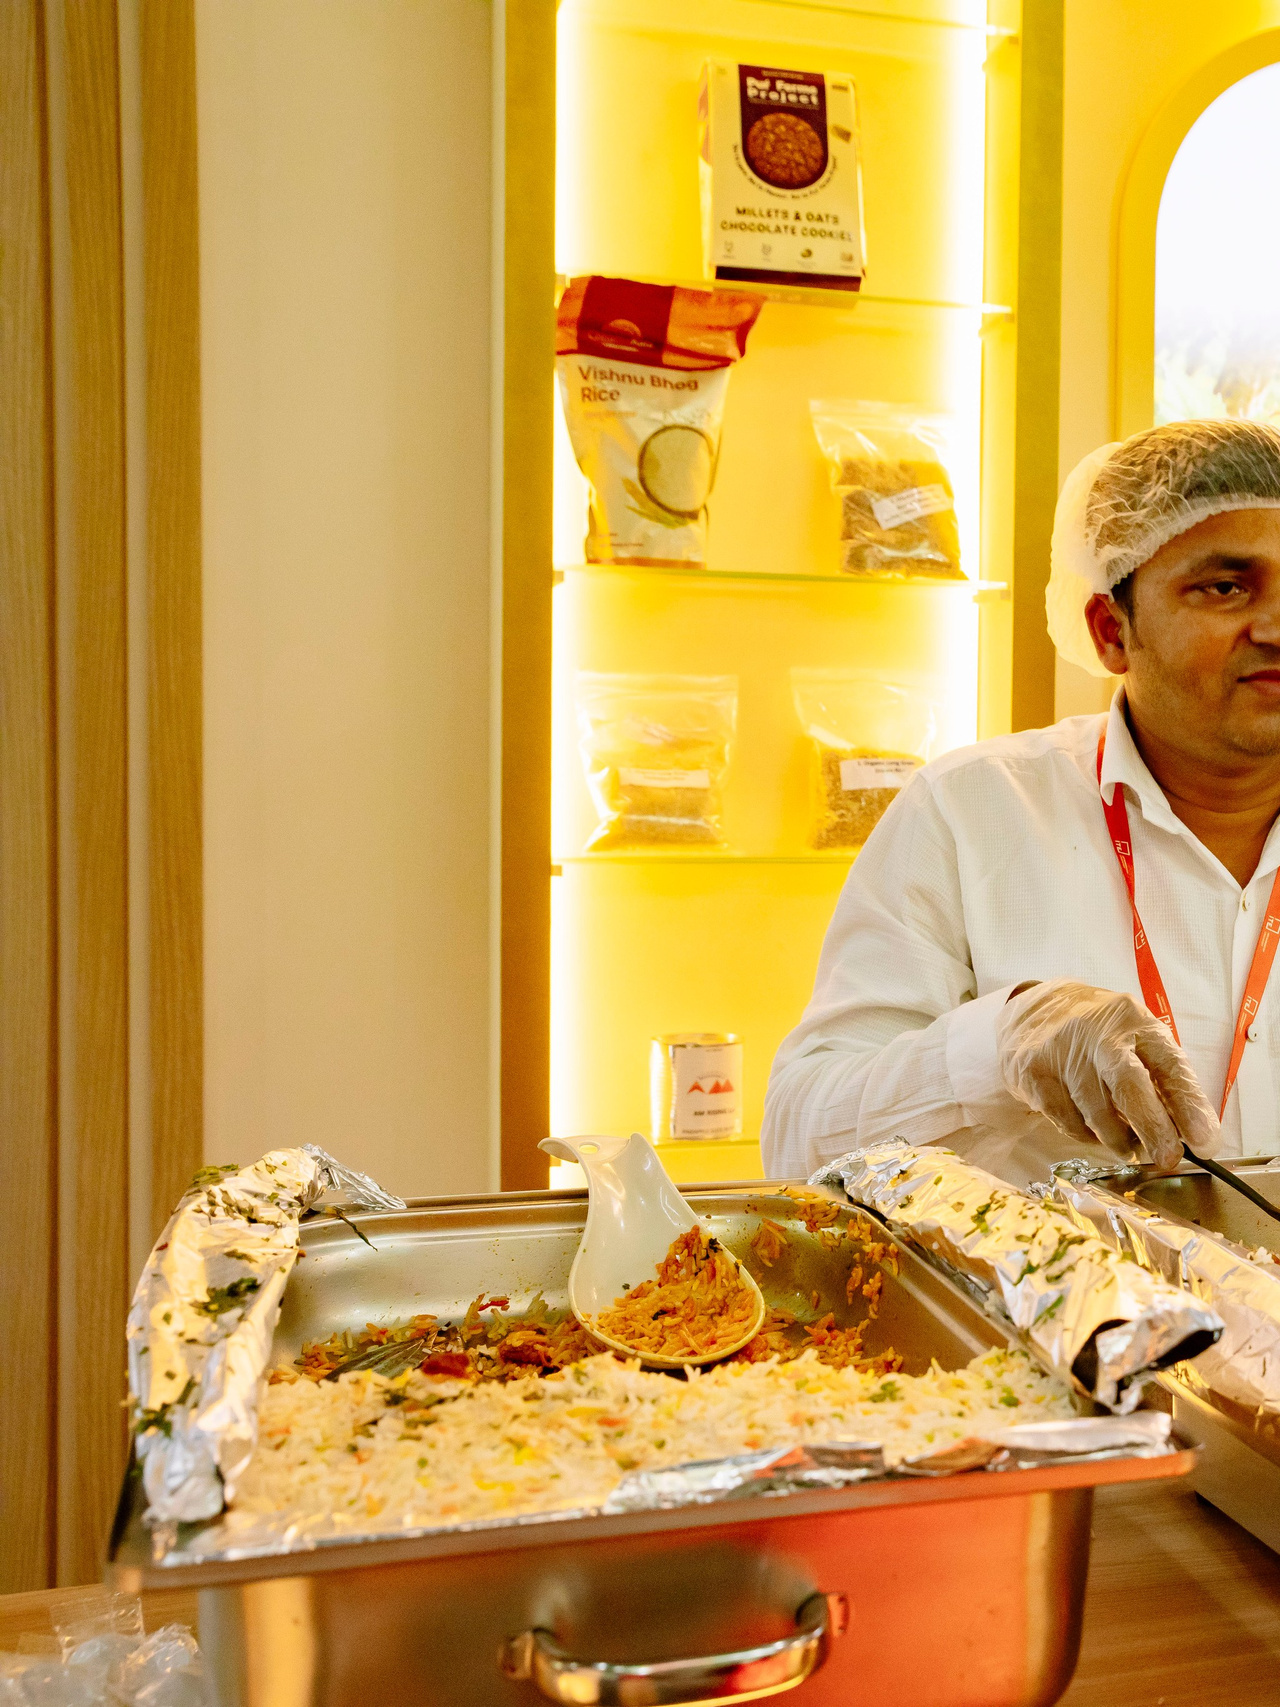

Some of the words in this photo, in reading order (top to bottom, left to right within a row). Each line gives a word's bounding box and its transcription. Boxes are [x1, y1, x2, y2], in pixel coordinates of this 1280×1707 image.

[735, 206, 789, 221] MILLETS
[794, 210, 801, 221] &
[805, 211, 839, 225] OATS
[720, 220, 797, 236] CHOCOLATE
[578, 366, 645, 385] Vishnu
[581, 386, 620, 402] Rice
